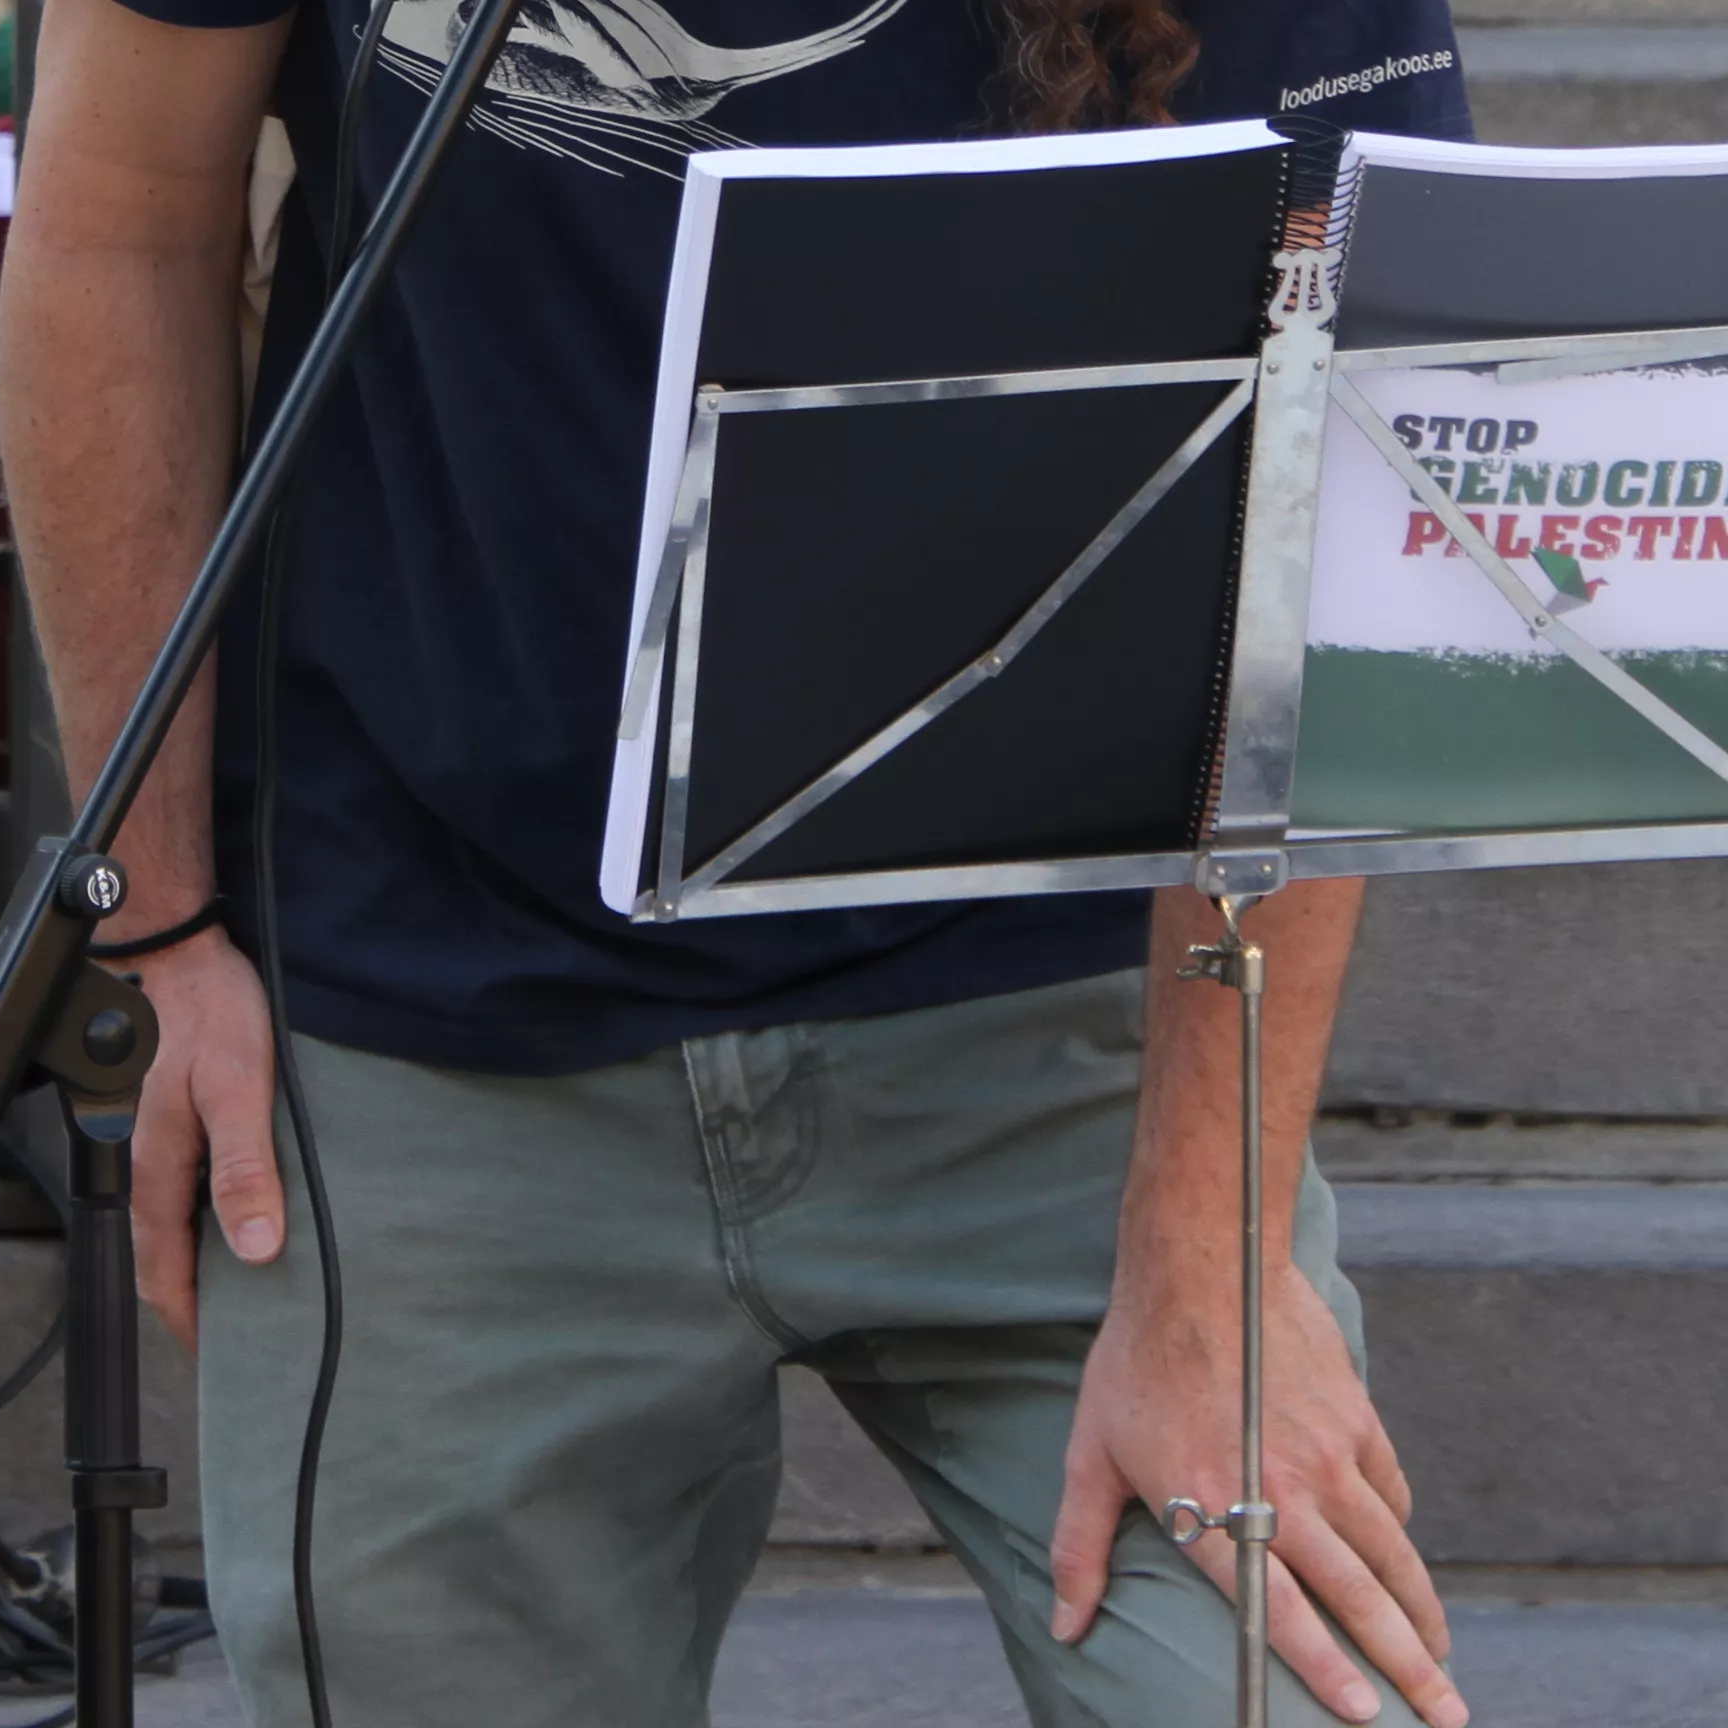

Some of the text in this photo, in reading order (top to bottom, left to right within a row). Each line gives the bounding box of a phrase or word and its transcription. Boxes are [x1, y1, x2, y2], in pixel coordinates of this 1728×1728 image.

[1279, 49, 1453, 111] loodusegakoos.ee
[1391, 414, 1539, 455] STOP
[95, 867, 112, 909] K&M
